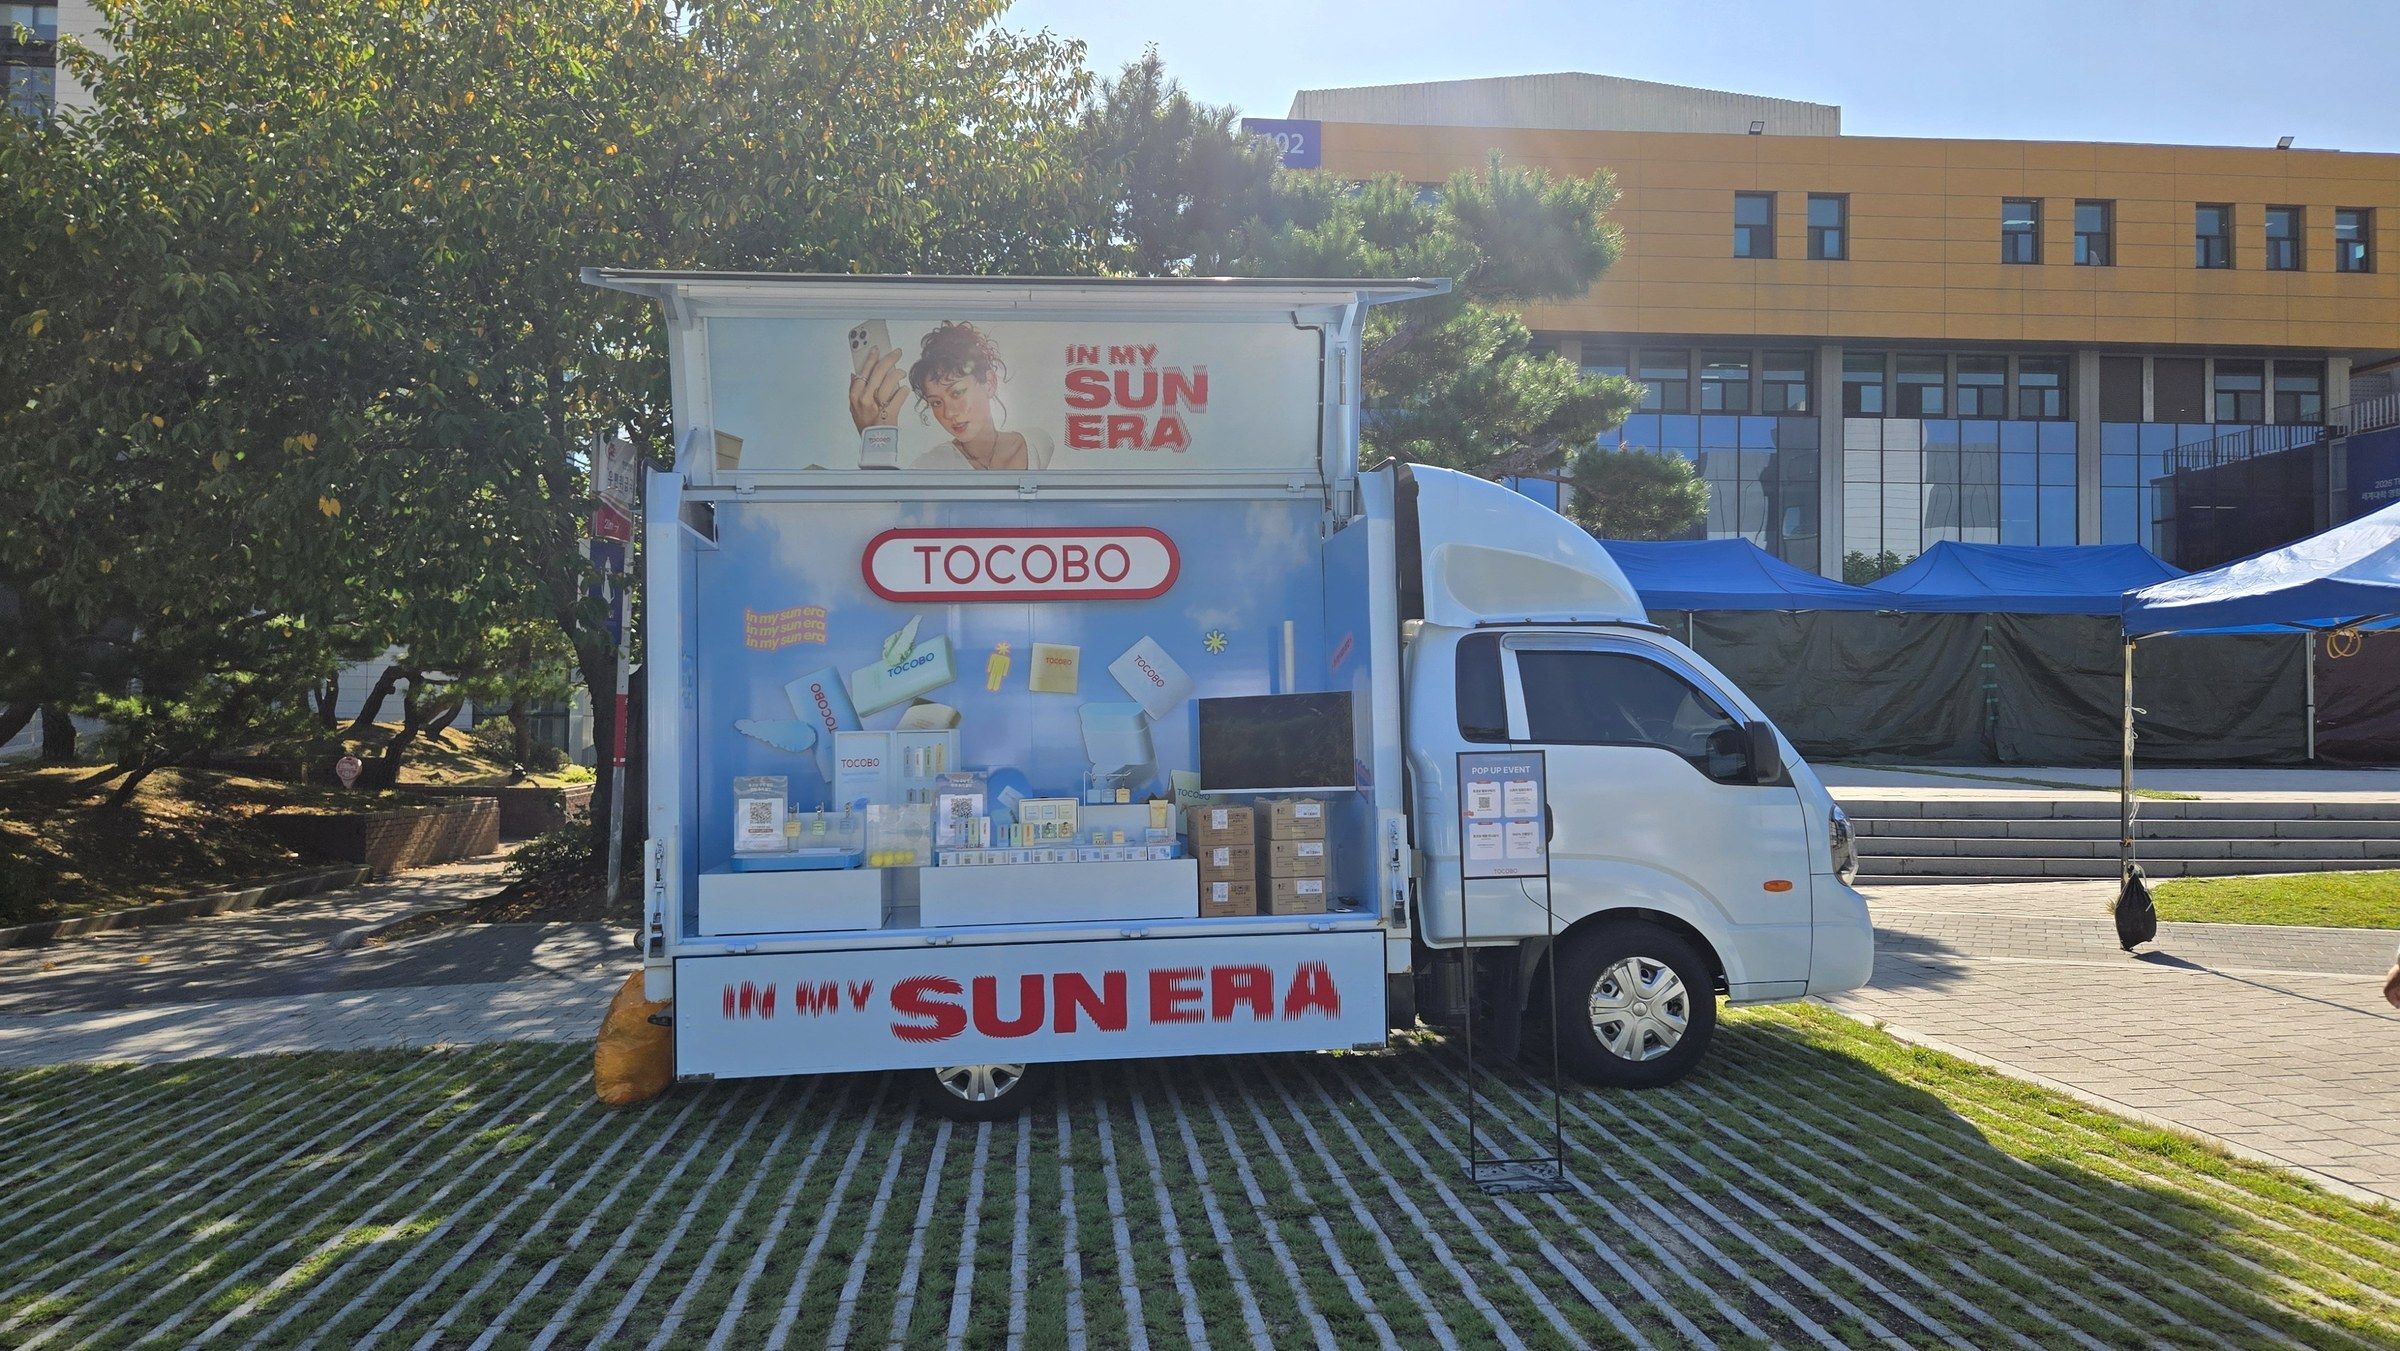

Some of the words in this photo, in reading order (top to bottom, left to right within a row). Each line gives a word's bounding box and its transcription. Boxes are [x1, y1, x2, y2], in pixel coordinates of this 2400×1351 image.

[1263, 132, 1304, 154] 02
[1065, 344, 1100, 366] IN
[1108, 343, 1159, 366] MY
[1064, 365, 1208, 414] SUN
[1064, 413, 1192, 453] ERA
[913, 543, 1131, 585] TOCOBO
[746, 609, 757, 623] in
[760, 613, 779, 625] my
[781, 608, 802, 619] sun
[803, 607, 825, 618] era
[746, 622, 757, 635] in
[760, 626, 779, 638] my
[781, 621, 802, 632] sun
[803, 619, 825, 630] era
[746, 634, 757, 647] in
[760, 638, 779, 650] my
[781, 633, 802, 645] sun
[803, 632, 825, 643] era
[887, 652, 935, 678] TOCOBO
[1045, 656, 1073, 667] TOCOBO
[1133, 654, 1165, 688] TOCOBO
[810, 683, 838, 734] TOCOBO
[840, 757, 880, 769] TOCOBO
[1472, 767, 1489, 775] POP
[1490, 766, 1501, 774] UP
[1503, 765, 1531, 774] EVENT
[1494, 867, 1518, 875] TOCOBO
[723, 980, 776, 1020] IN
[795, 978, 874, 1018] MY
[890, 969, 1127, 1043] SUN
[1148, 959, 1341, 1025] ERA
